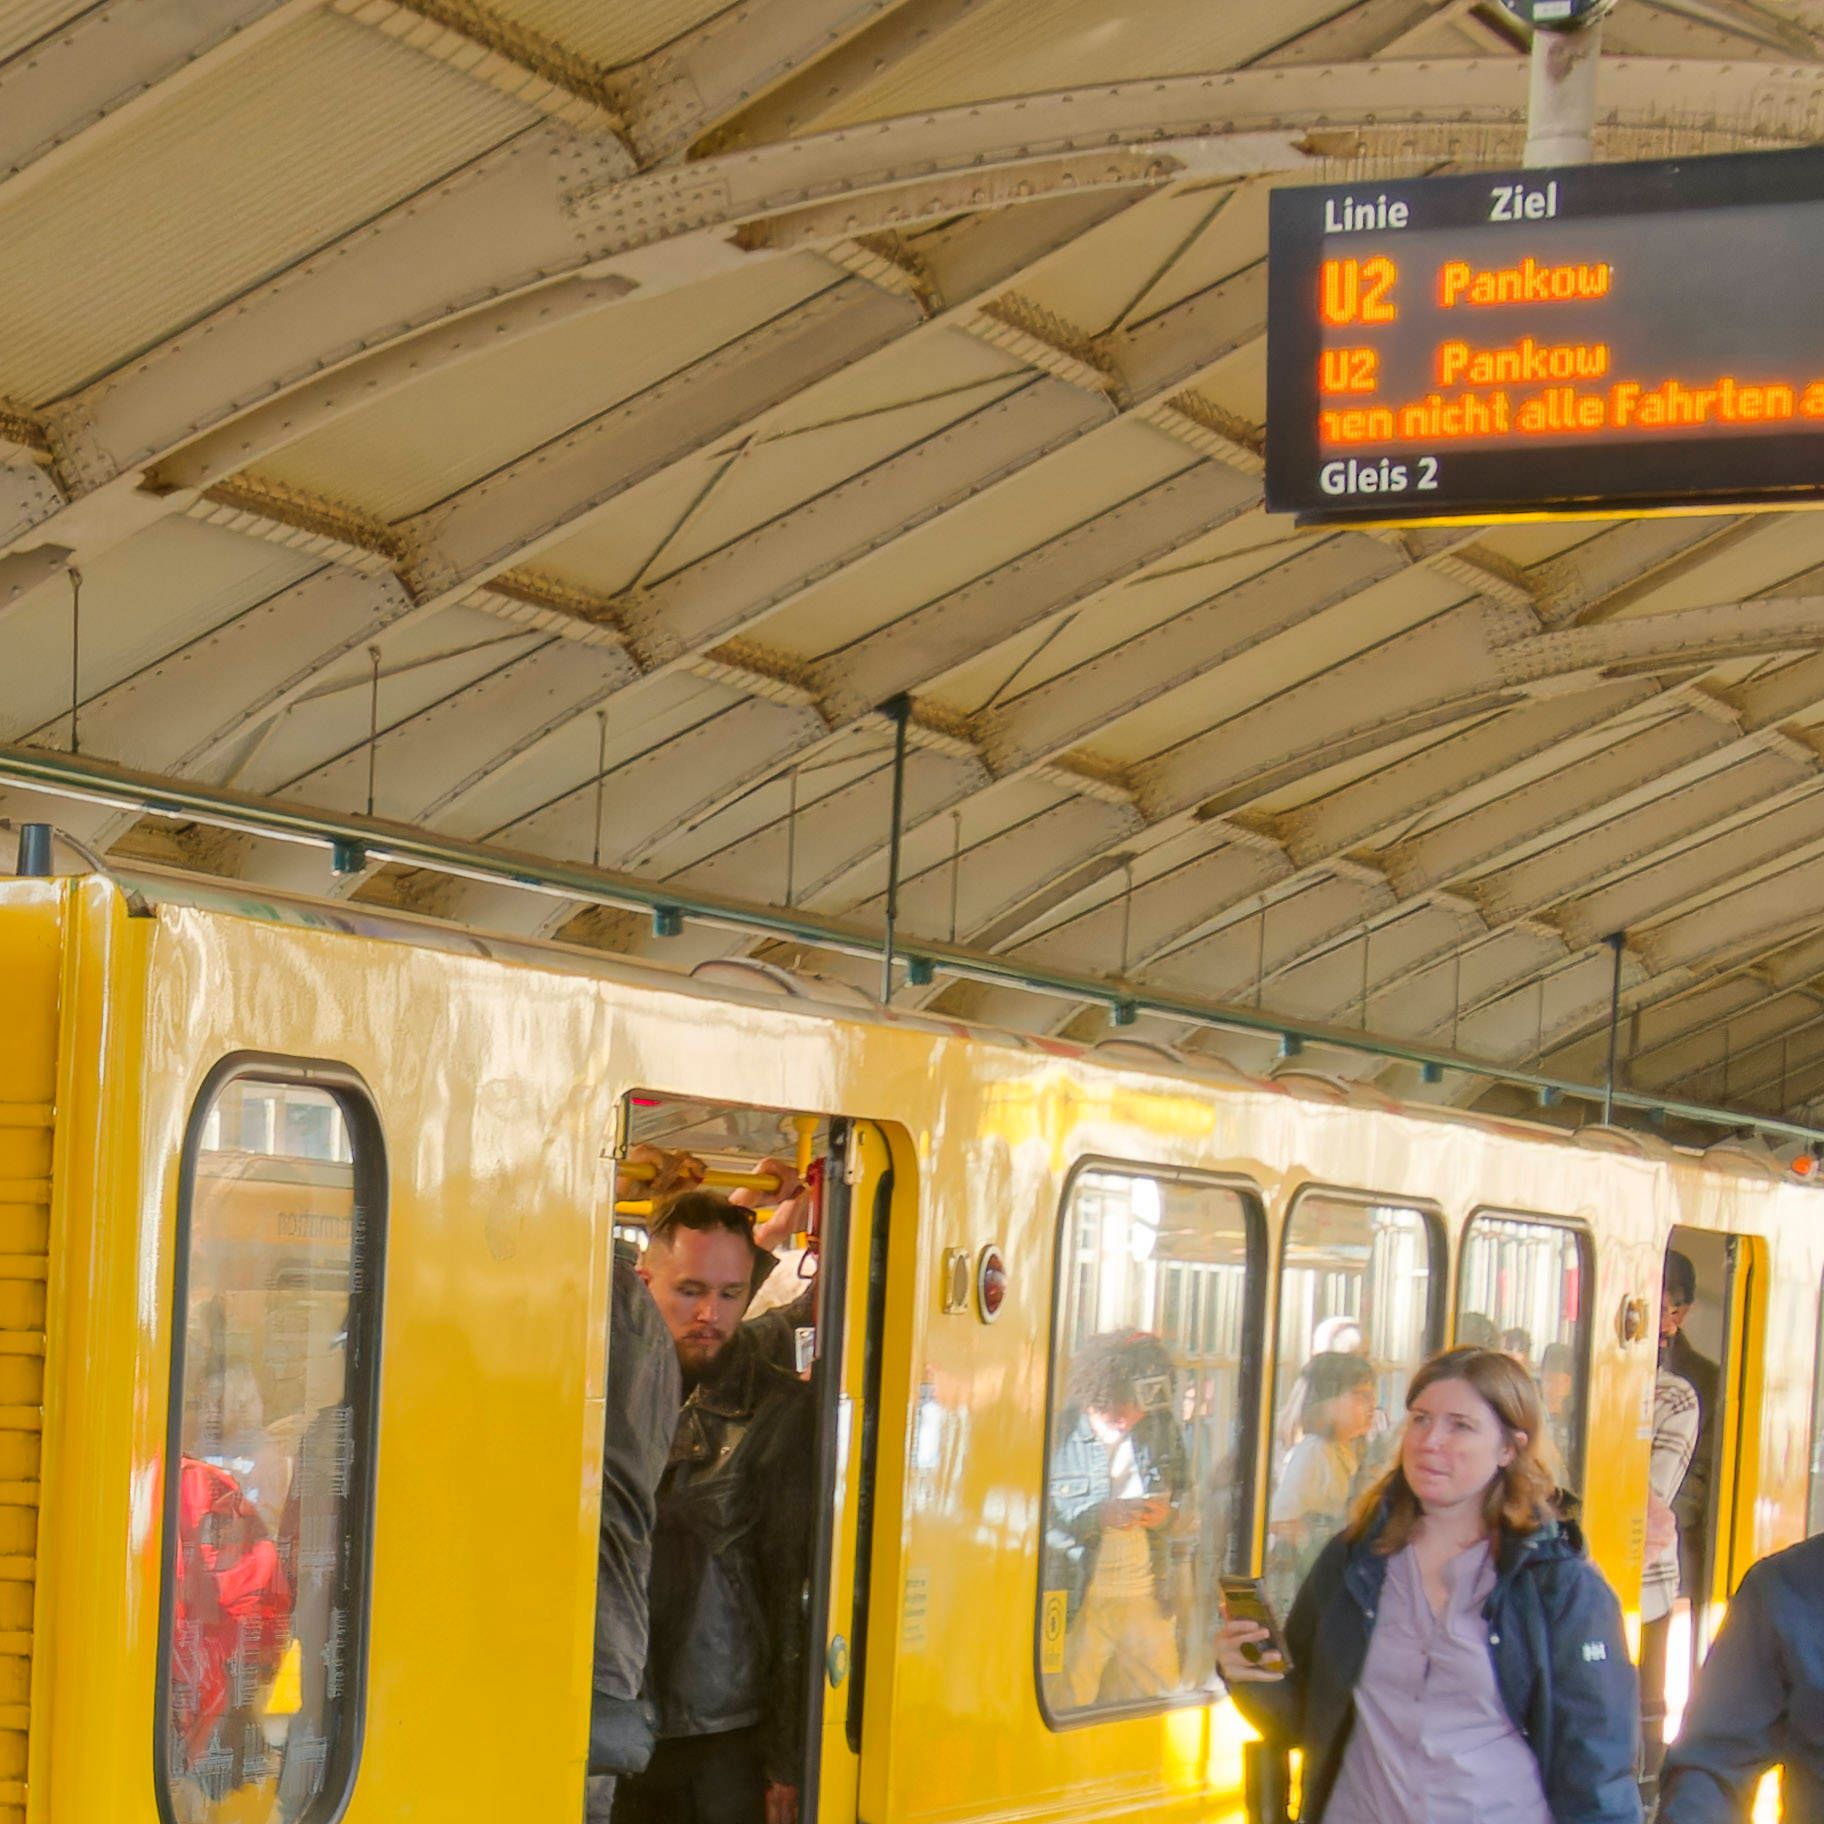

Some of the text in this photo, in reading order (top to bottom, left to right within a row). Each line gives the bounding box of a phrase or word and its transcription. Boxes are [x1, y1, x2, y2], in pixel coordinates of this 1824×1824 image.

[1324, 181, 1558, 233] Linie Ziel
[1322, 256, 1610, 324] U2 Pankow
[1322, 337, 1607, 393] U2 Pankow
[1400, 393, 1510, 438] nicht
[1517, 386, 1605, 431] alle
[1609, 375, 1794, 427] Fahrten
[1320, 456, 1439, 495] Gleis 2
